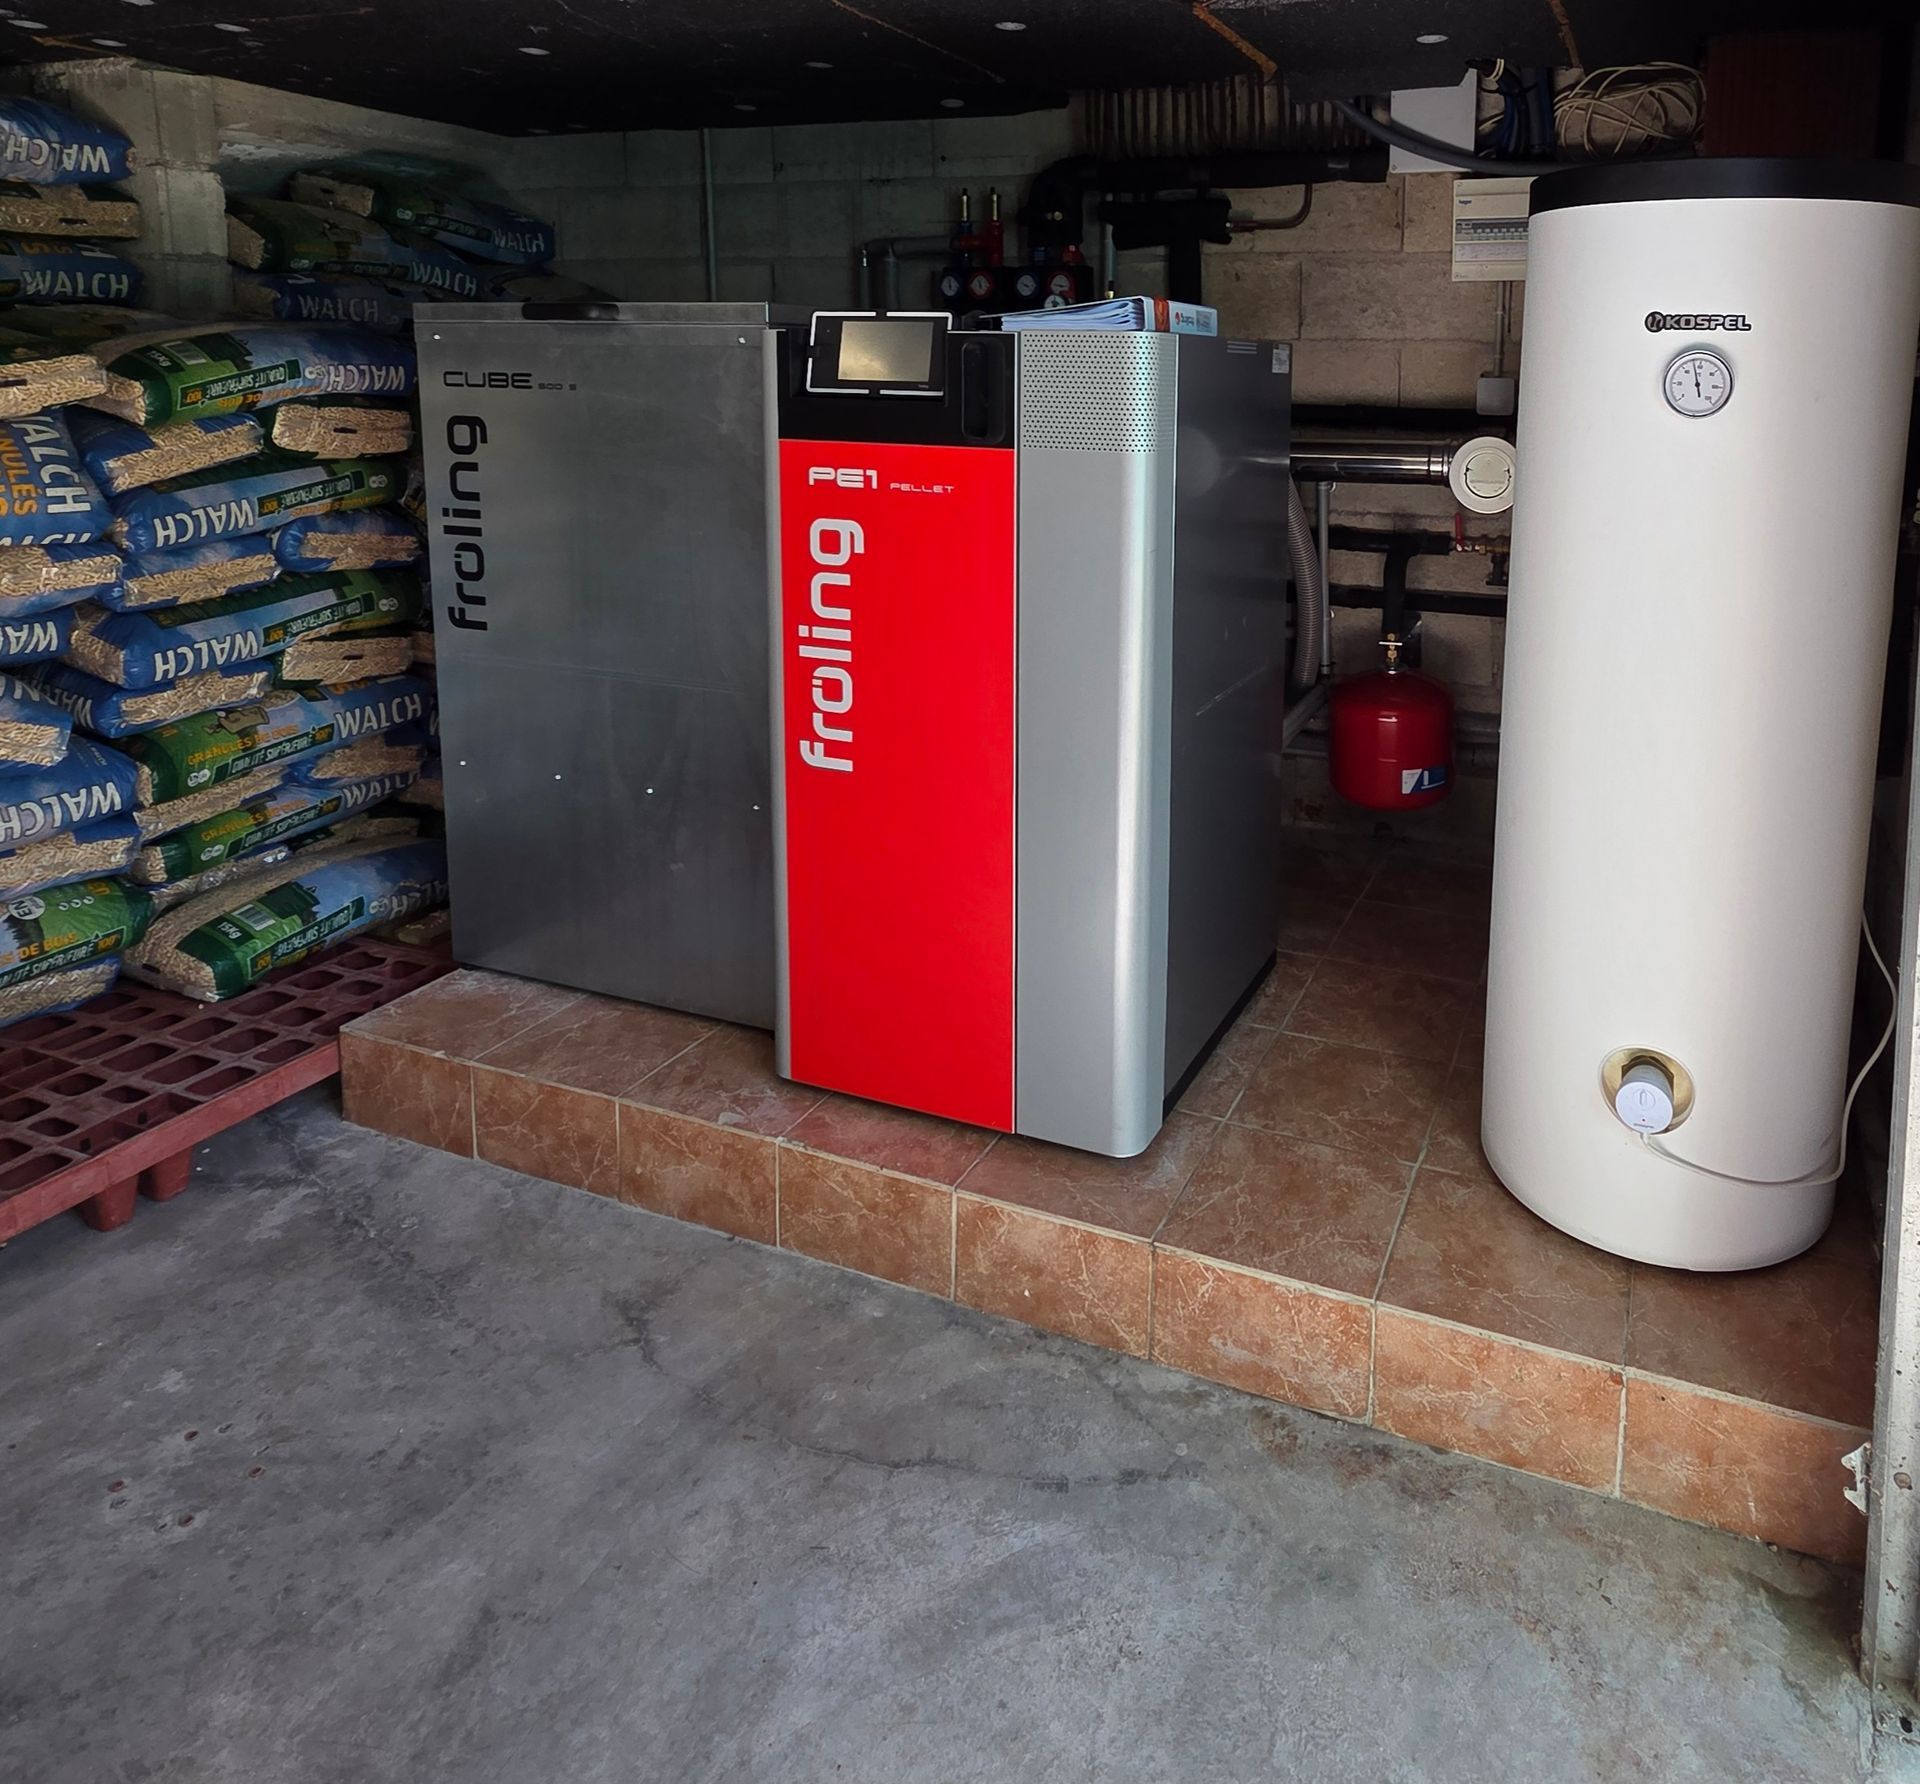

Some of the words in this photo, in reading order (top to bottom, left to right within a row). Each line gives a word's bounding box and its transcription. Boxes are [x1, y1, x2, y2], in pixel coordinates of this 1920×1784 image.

[6, 134, 110, 173] WALCH
[490, 228, 545, 253] WALCH
[22, 269, 129, 299] WALCH
[411, 261, 477, 297] WALCH
[297, 295, 378, 321] WALCH
[1665, 315, 1751, 331] KOSPEL
[326, 364, 405, 391] WALCH
[444, 371, 532, 389] CUBE
[0, 430, 43, 516] NULÉS
[808, 466, 878, 489] PE1
[890, 483, 955, 493] PELLET
[153, 498, 255, 548] WALCH
[442, 414, 488, 631] fröling
[0, 621, 58, 655] WA
[154, 630, 258, 681] WALCH
[798, 517, 865, 772] fröling
[335, 692, 422, 738] WALCH
[0, 782, 121, 843] WALCH
[20, 943, 39, 959] DE
